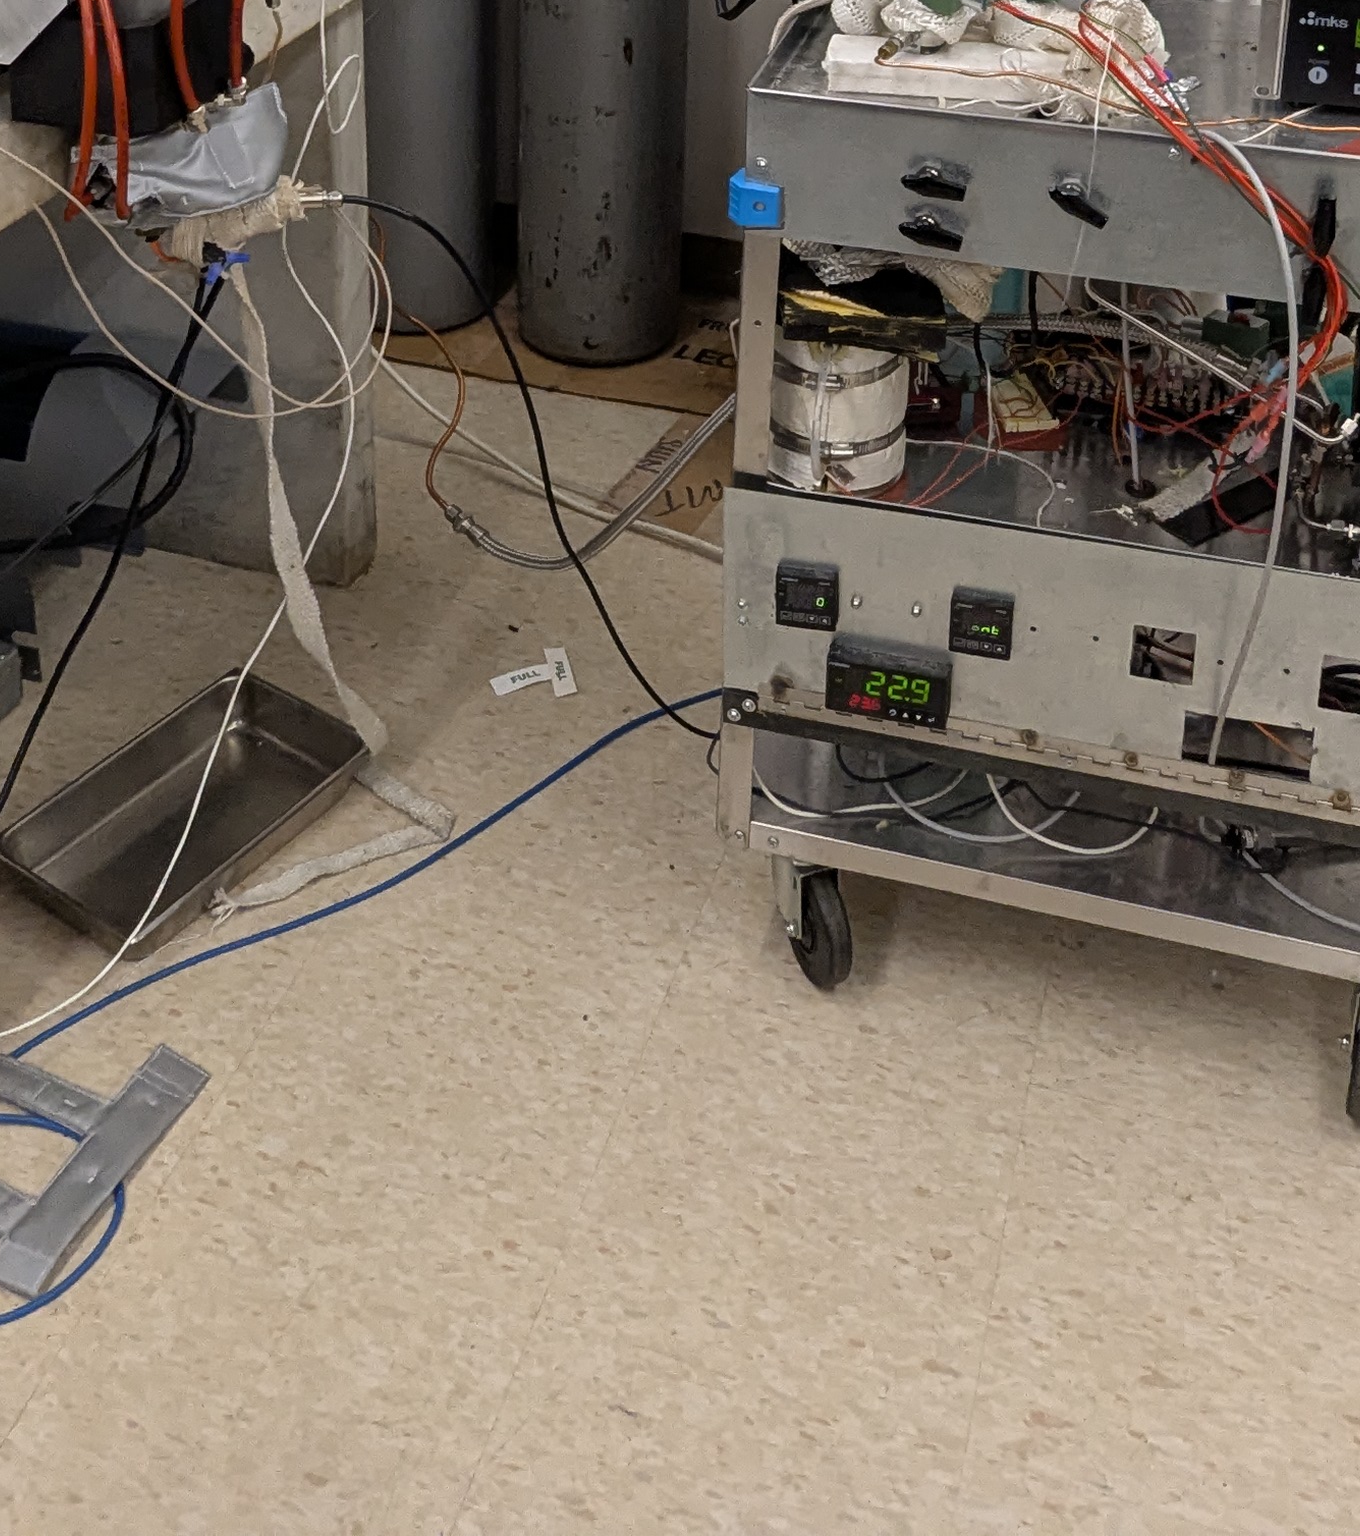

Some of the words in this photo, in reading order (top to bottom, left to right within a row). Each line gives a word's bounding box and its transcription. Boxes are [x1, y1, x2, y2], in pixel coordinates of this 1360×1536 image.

[1314, 15, 1349, 29] mks
[510, 669, 541, 684] FULL
[865, 670, 931, 705] 22.9
